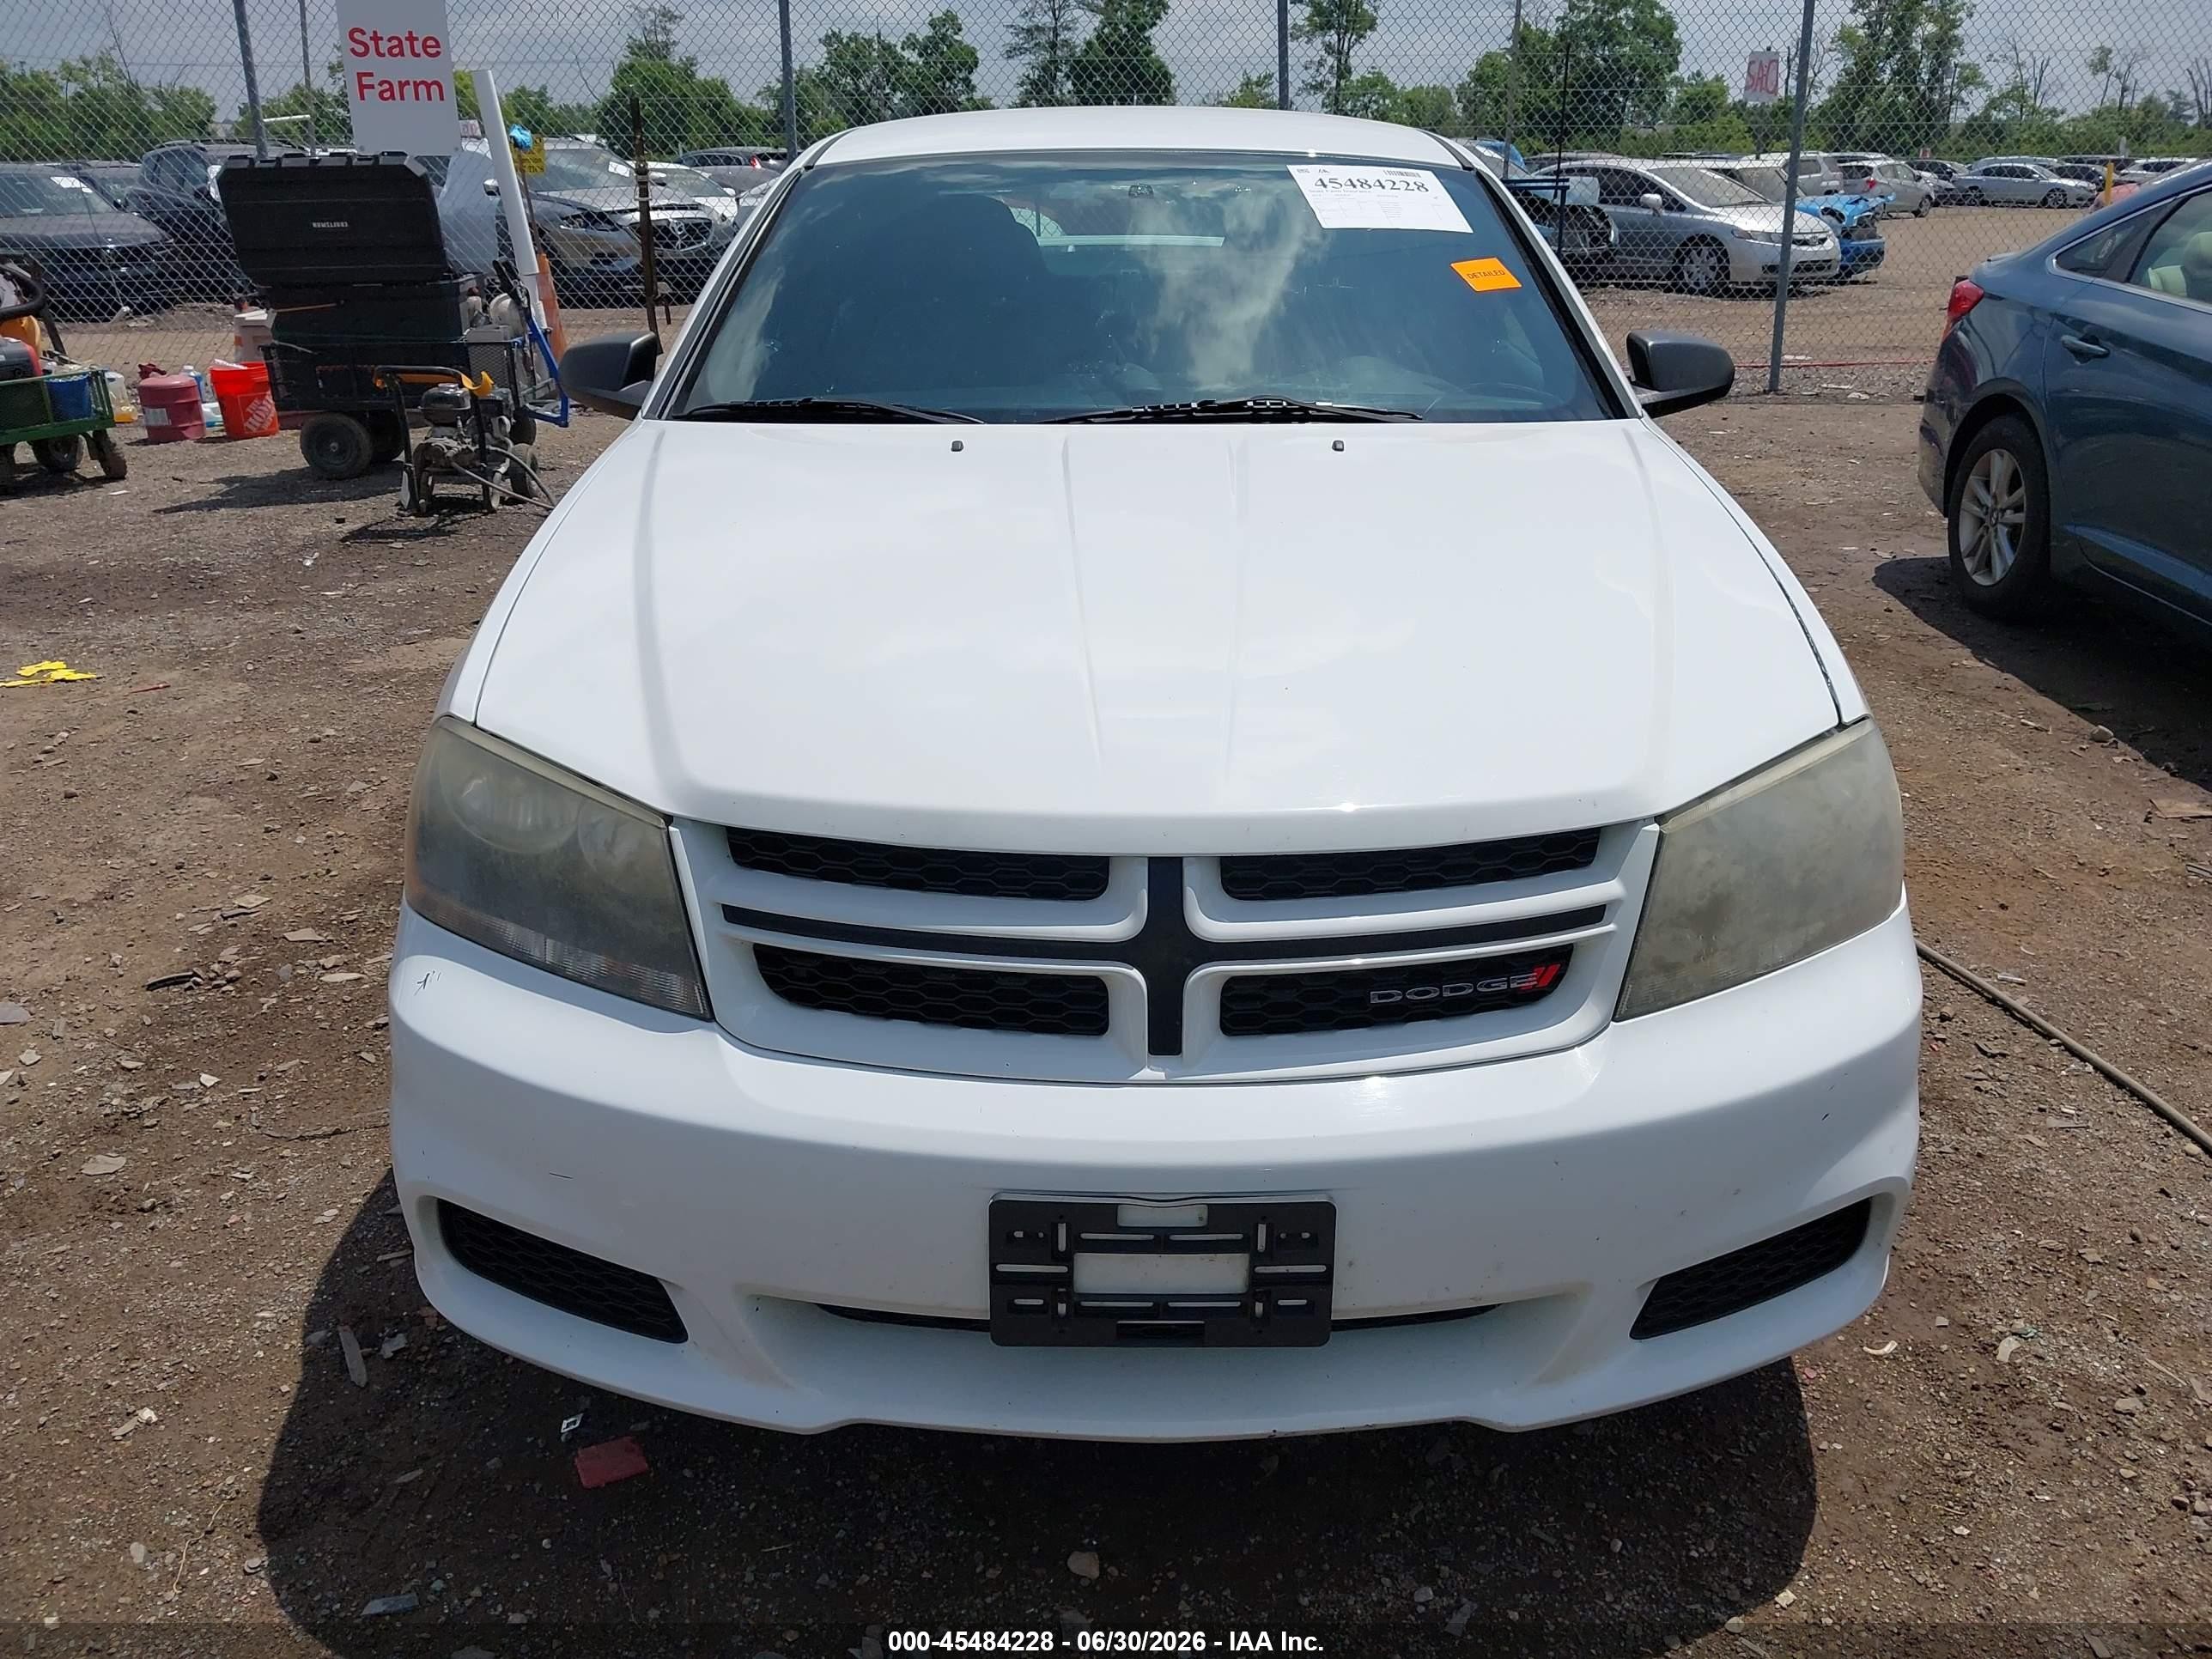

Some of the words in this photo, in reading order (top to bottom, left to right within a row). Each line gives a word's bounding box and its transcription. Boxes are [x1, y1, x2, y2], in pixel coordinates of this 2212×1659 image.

[348, 27, 441, 58] State
[356, 71, 445, 101] Farm
[1314, 178, 1430, 192] 45484228
[1467, 270, 1505, 279] DETAILED
[1370, 972, 1538, 1004] DODGE
